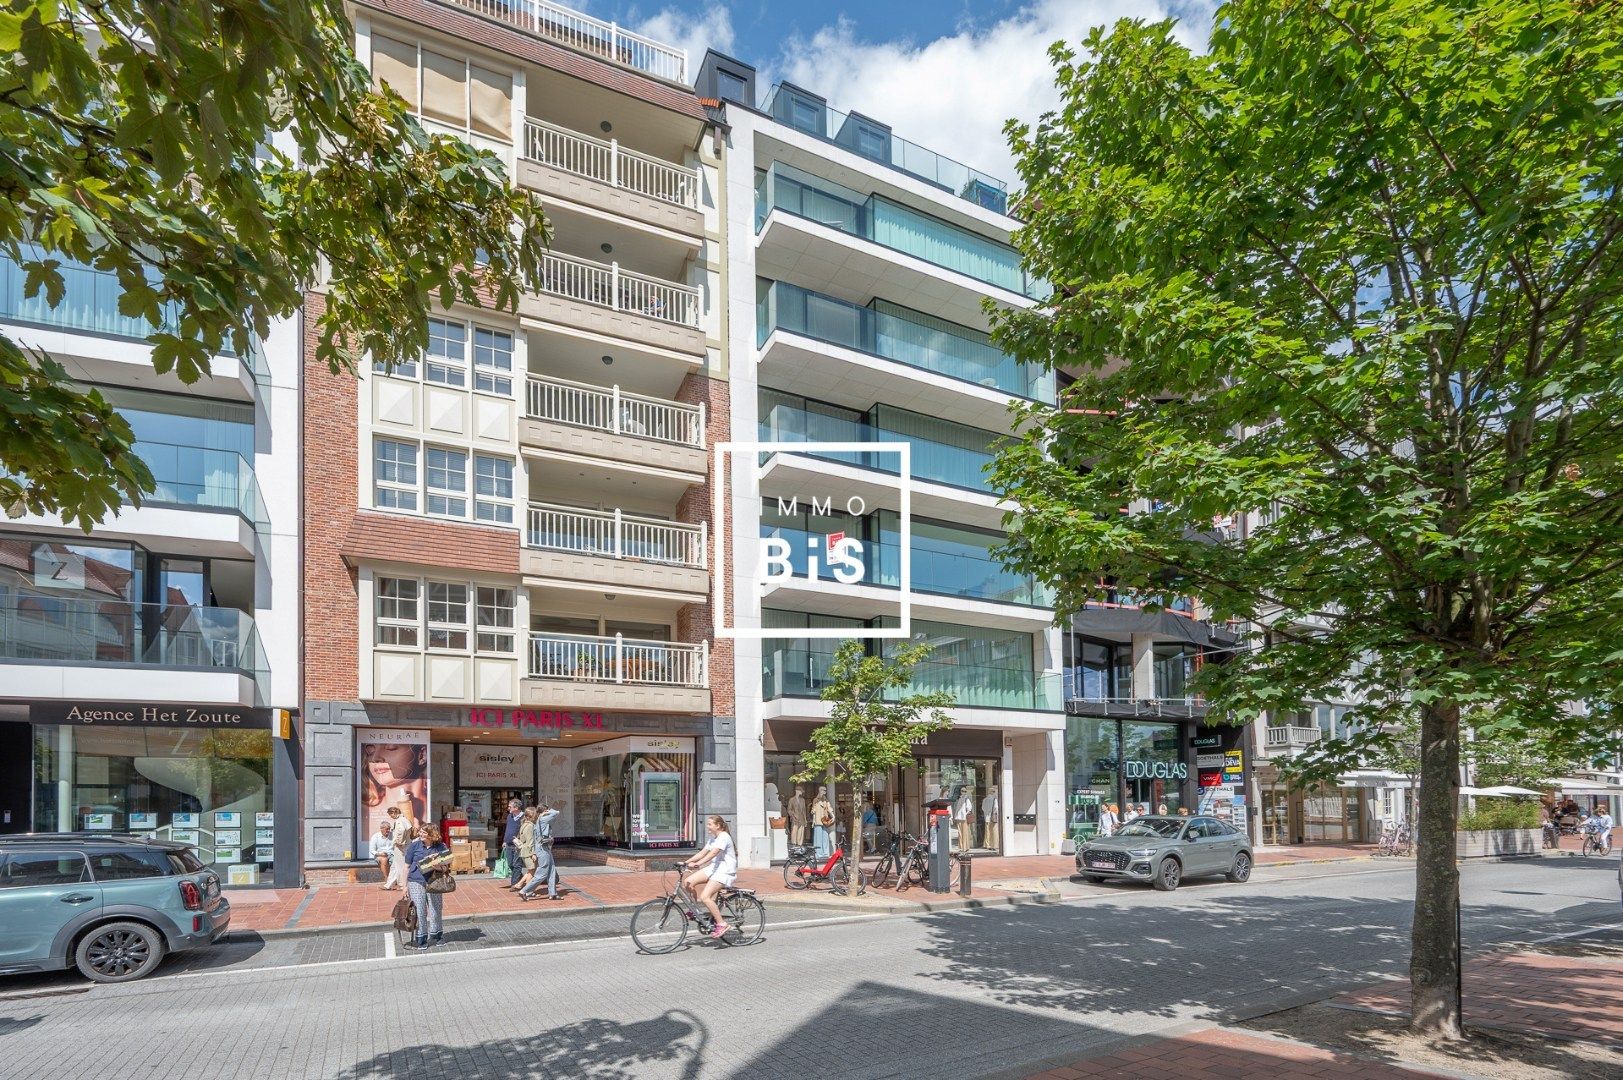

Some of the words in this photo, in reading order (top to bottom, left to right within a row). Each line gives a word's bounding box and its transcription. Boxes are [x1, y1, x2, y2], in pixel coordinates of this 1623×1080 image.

[66, 706, 135, 723] Agence
[142, 707, 178, 722] Het
[186, 708, 241, 723] Zoute
[470, 707, 504, 726] ICI
[511, 709, 574, 729] PARIS
[479, 754, 514, 763] sisley
[1126, 760, 1187, 779] DOUGLAS
